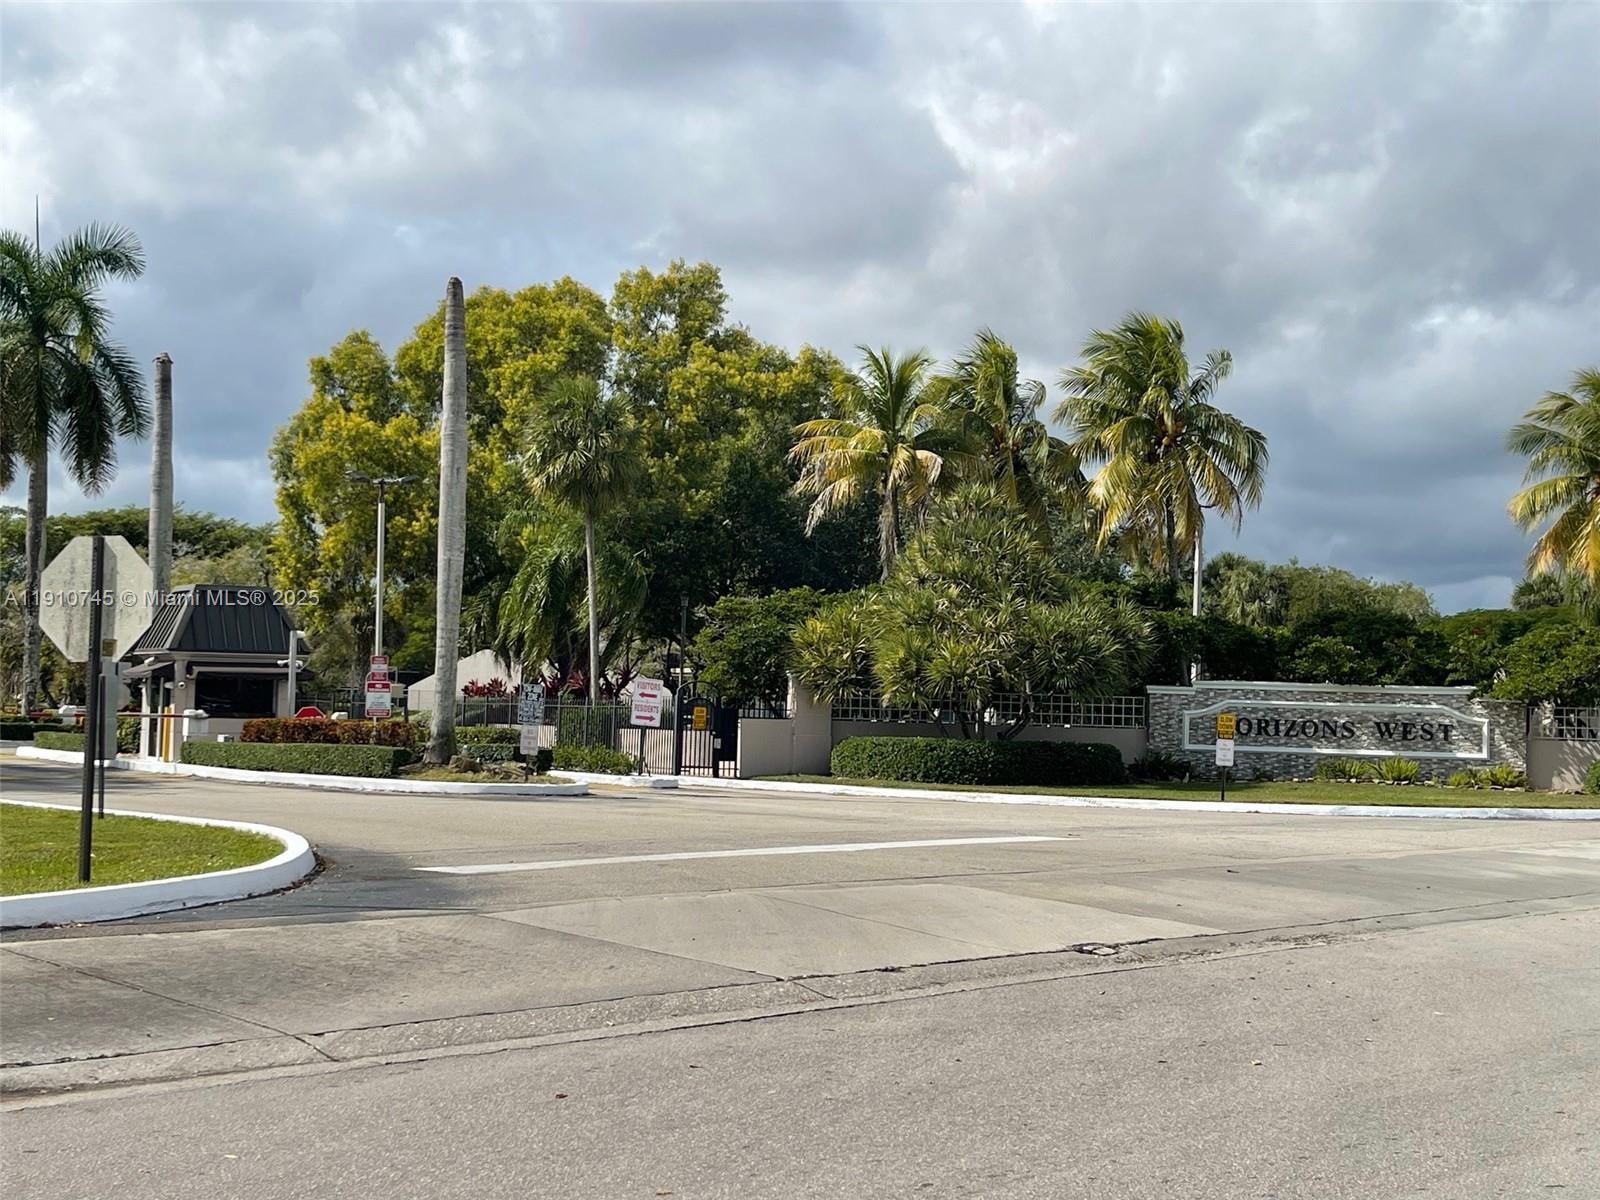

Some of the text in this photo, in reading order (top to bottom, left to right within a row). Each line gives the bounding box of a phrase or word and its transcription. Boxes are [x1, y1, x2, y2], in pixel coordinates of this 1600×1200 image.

[637, 681, 660, 691] VISITORS
[634, 704, 659, 714] RESIDENTS
[1235, 717, 1455, 741] ORIZONS WEST
